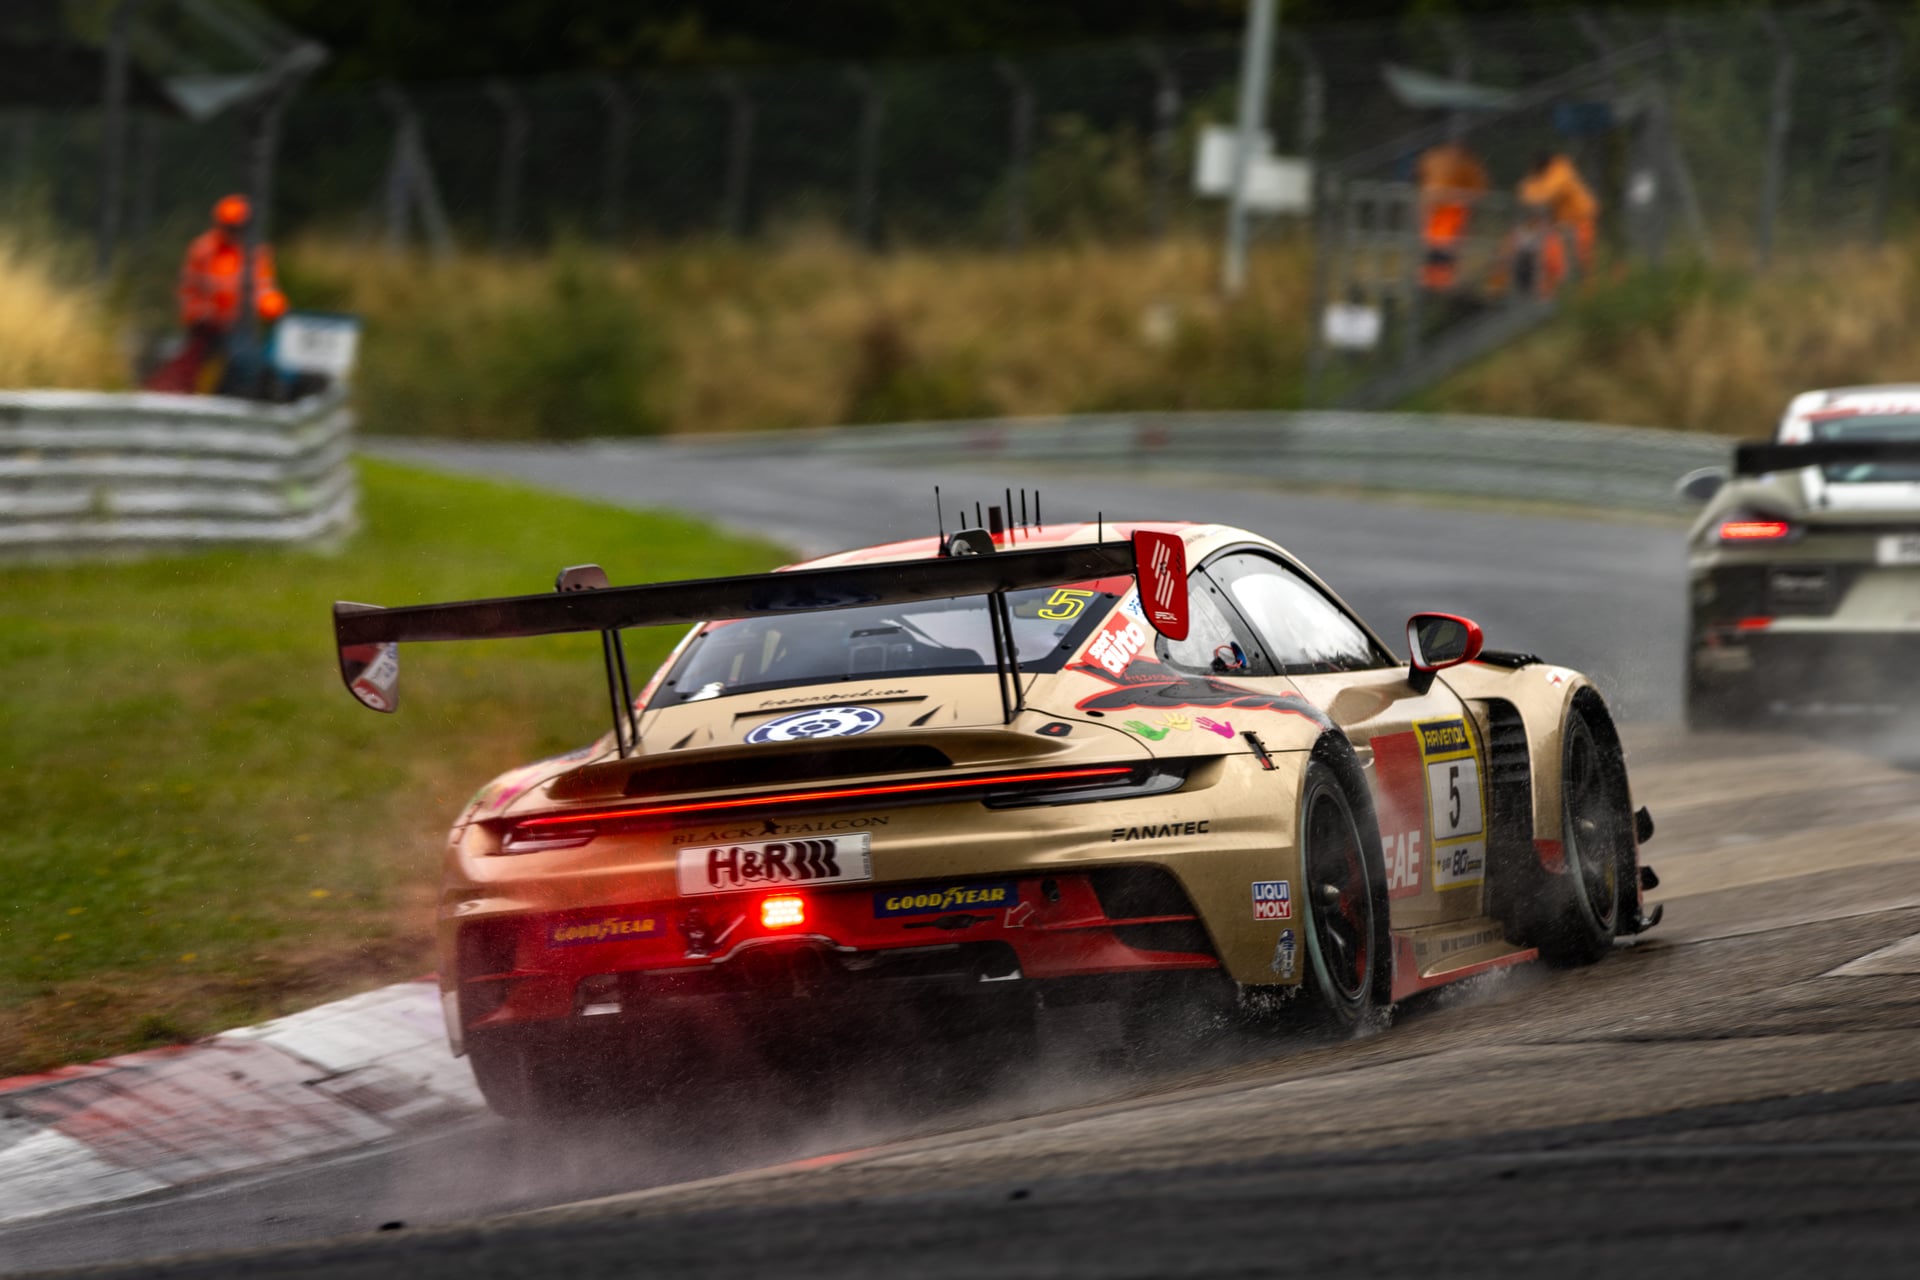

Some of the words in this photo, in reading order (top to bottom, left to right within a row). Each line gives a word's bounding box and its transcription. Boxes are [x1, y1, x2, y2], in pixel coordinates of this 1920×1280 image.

[1038, 588, 1094, 620] 5
[1100, 621, 1146, 674] auto
[1424, 726, 1466, 747] RAVENOL
[1448, 765, 1461, 829] 5
[671, 828, 757, 846] BLACK
[784, 816, 890, 835] FALCON
[1111, 820, 1210, 842] FANATEC
[707, 840, 800, 888] H&R
[885, 886, 1006, 910] GOODYEAR
[1254, 883, 1289, 901] LIQUI
[1255, 901, 1290, 918] MOLY
